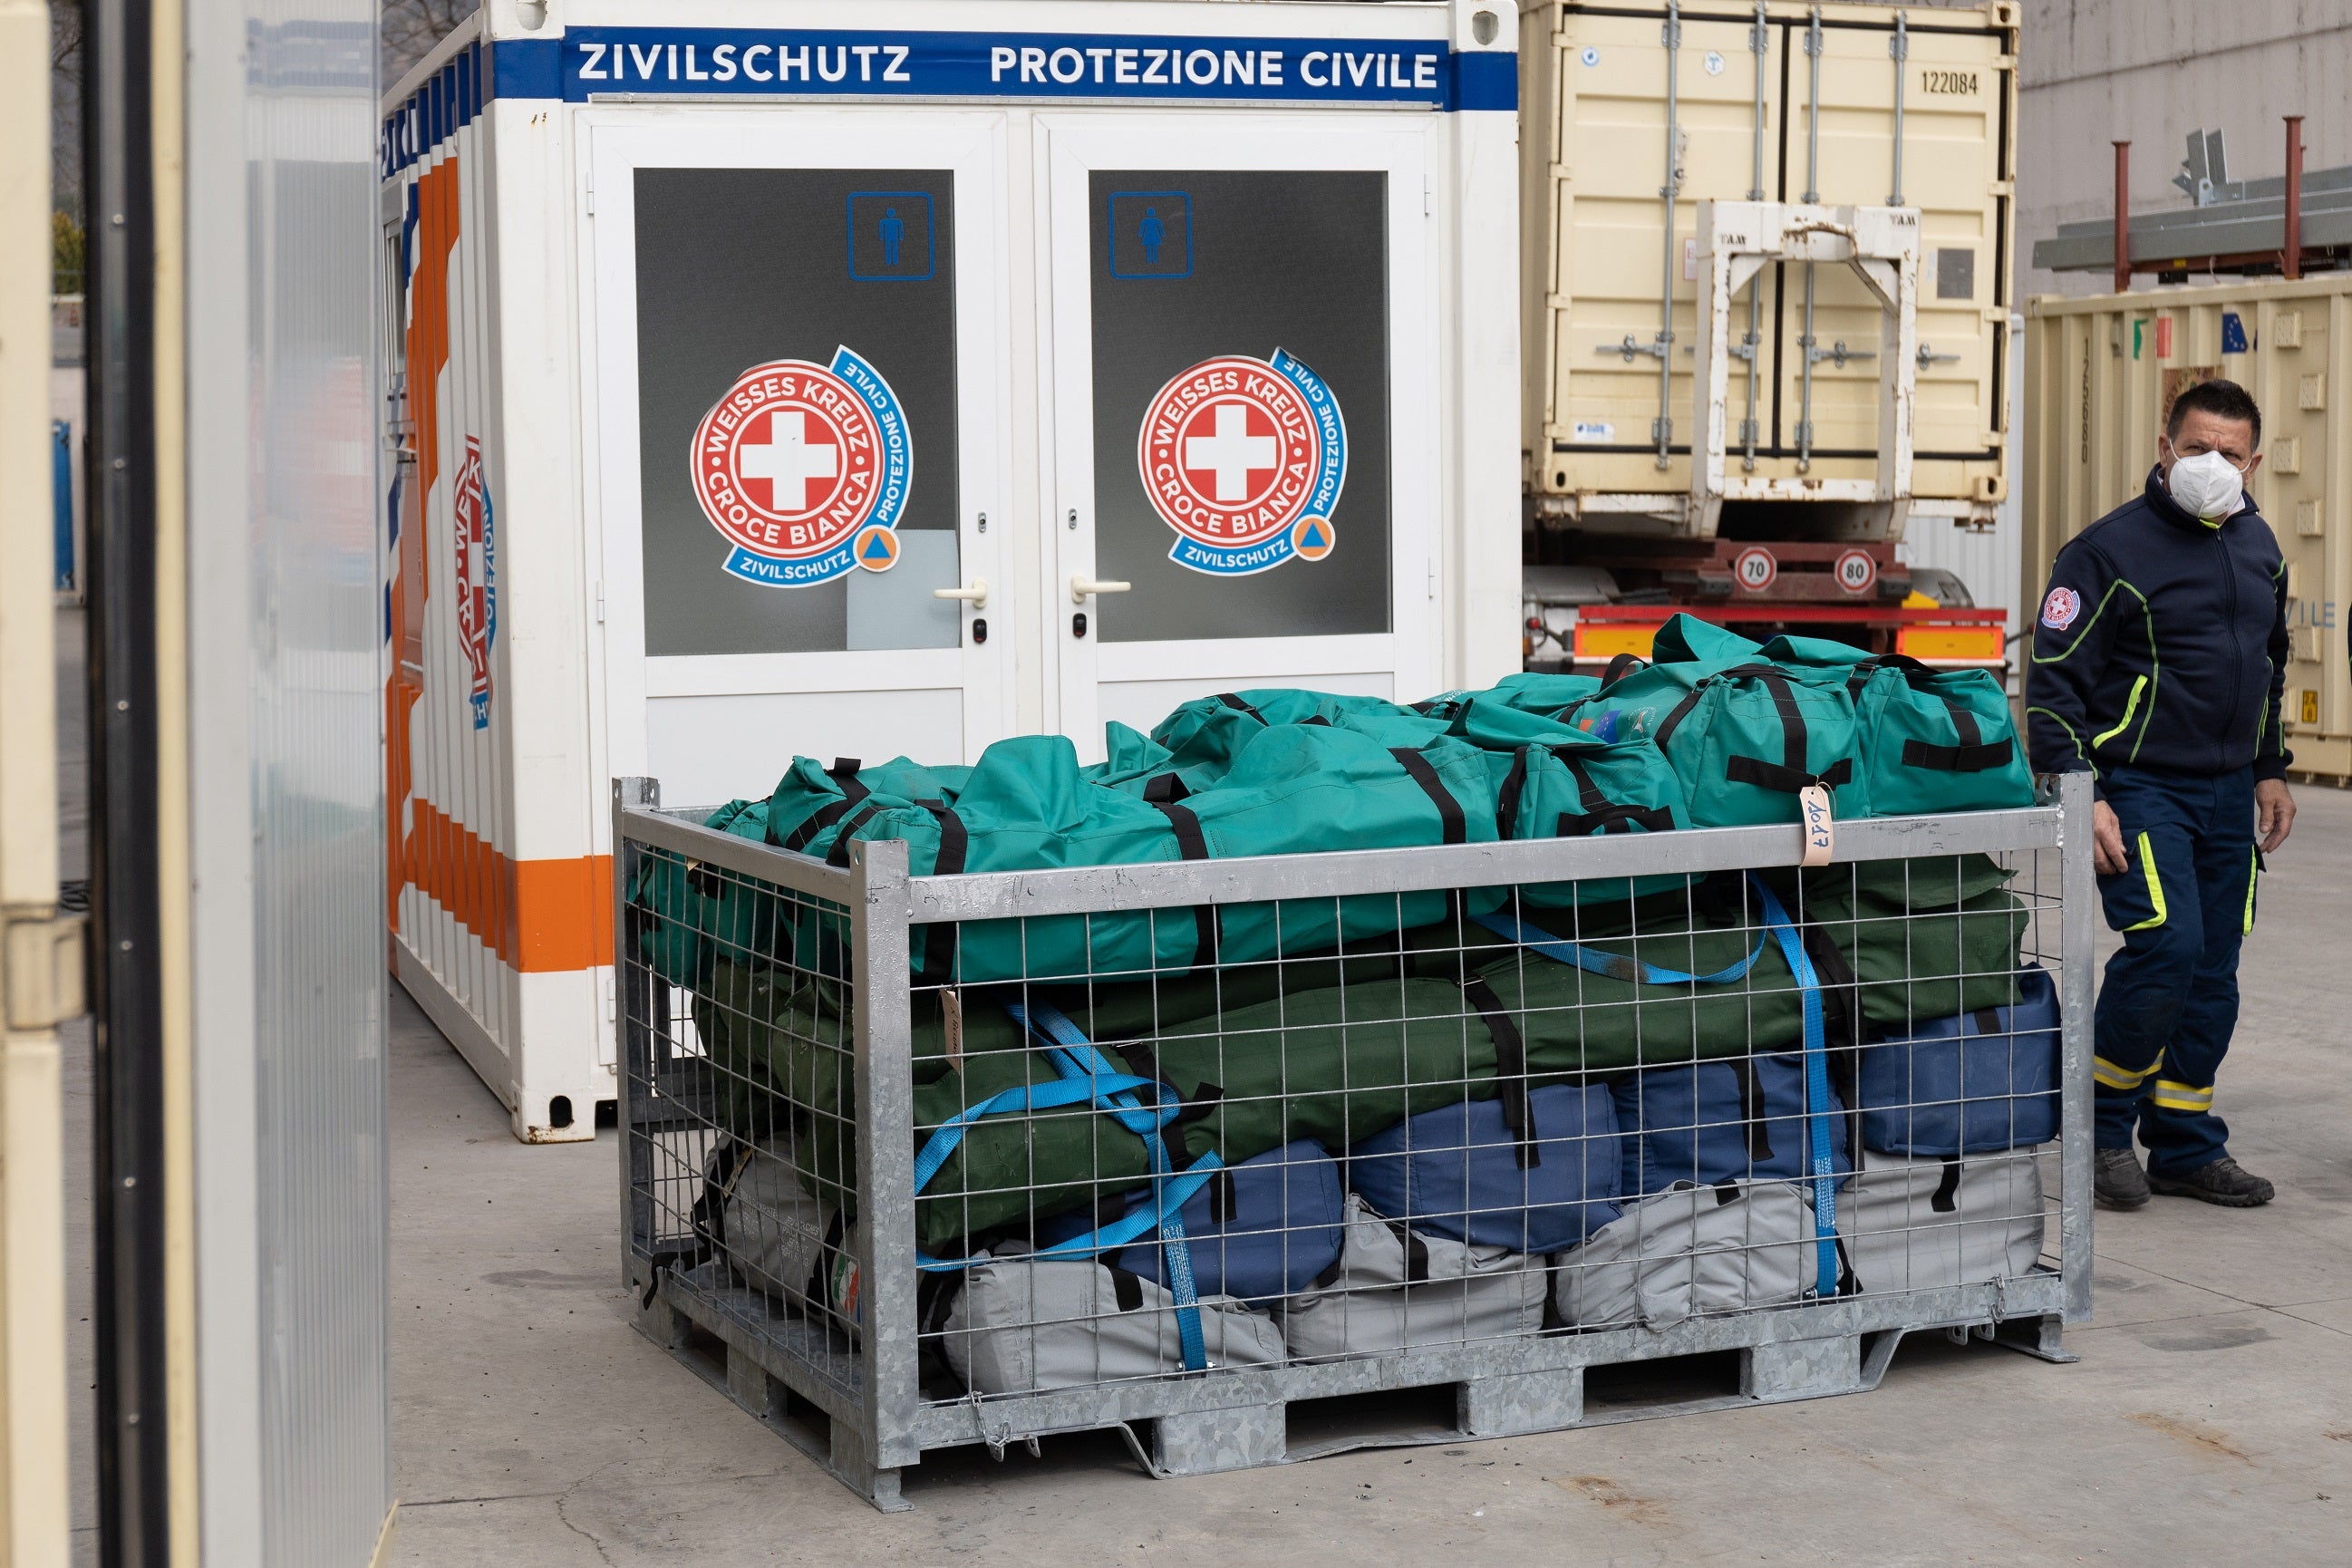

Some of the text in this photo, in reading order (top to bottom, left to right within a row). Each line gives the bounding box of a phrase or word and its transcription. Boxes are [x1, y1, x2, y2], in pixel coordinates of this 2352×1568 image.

[579, 44, 1437, 89] ZIVILSCHUTZ PROTEZIONE CIVILE
[1922, 71, 1978, 94] 122084
[707, 376, 869, 453] WEISSES KREUZ
[1154, 372, 1307, 445] WEISSES KREUZ
[844, 362, 905, 522] PROTEZIONE CIVILE
[1283, 358, 1340, 512] PROTEZIONE CIVILE
[709, 469, 870, 546] CROCE BIANCA
[1156, 461, 1308, 535] CROCE BIANCA
[740, 549, 851, 580] ZIVILSCHUTZ
[1185, 538, 1289, 567] ZIVILSCHUTZ
[1747, 561, 1765, 577] 70
[1846, 563, 1864, 579] 80
[1807, 800, 1829, 847] 1017
